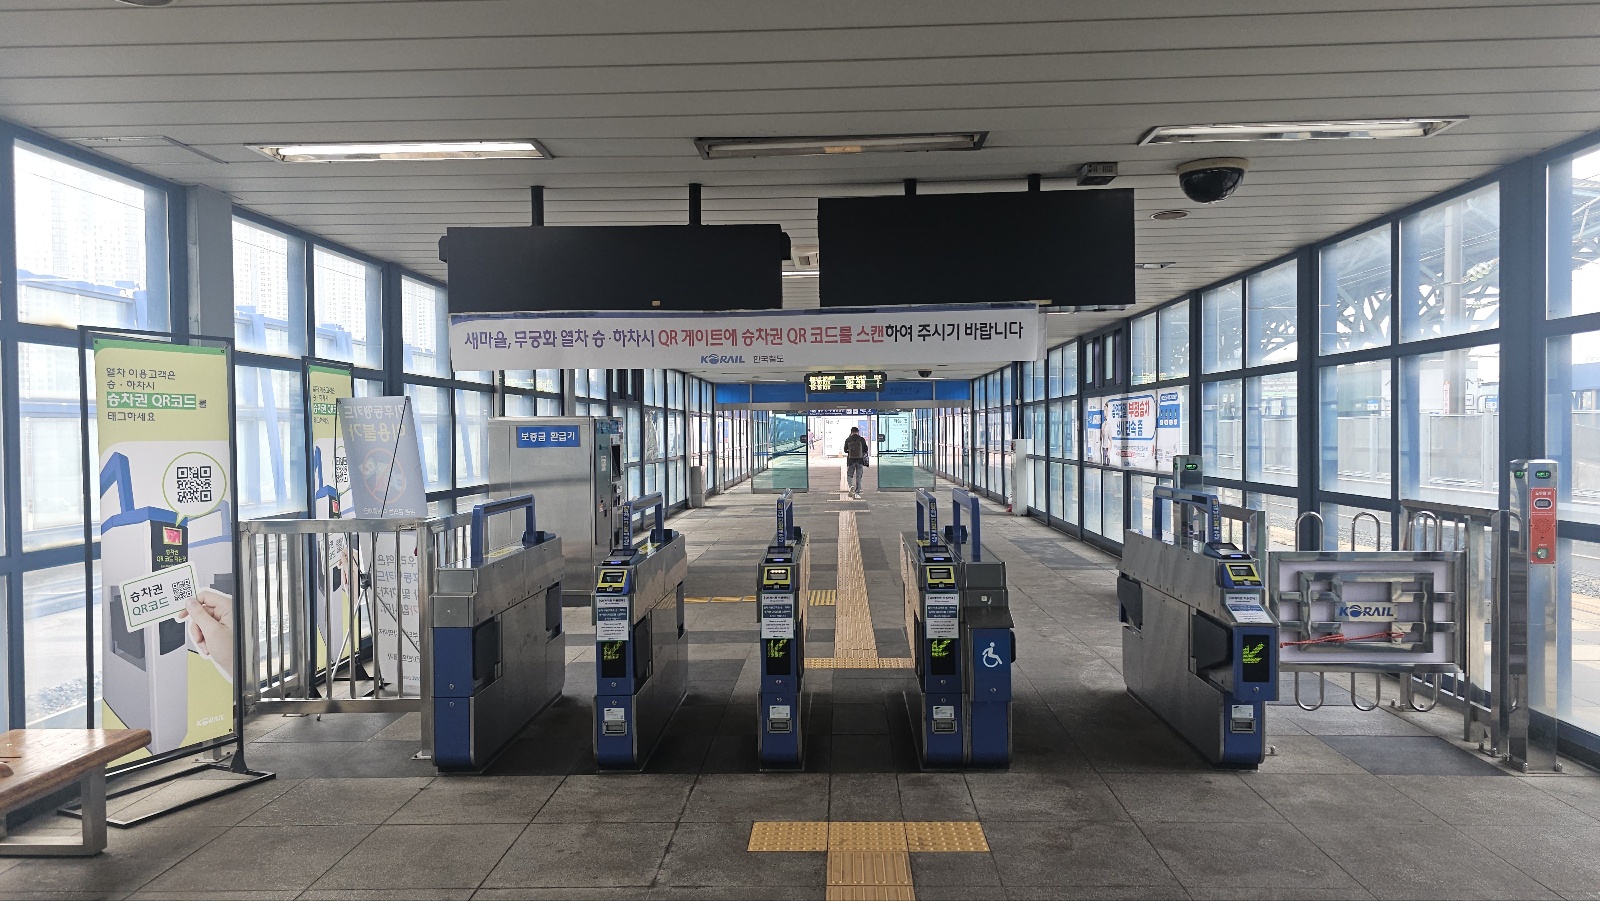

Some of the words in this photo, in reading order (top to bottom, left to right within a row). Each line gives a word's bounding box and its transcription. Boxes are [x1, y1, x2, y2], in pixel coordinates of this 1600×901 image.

[464, 331, 511, 350] 새마을,
[514, 329, 557, 349] 무궁화
[560, 329, 588, 348] 열차
[658, 329, 678, 348] QR
[681, 328, 737, 348] 게이트에
[741, 327, 783, 346] 승차권
[787, 327, 807, 345] QR
[810, 325, 852, 345] 코드를
[856, 323, 913, 344] 스캔하여
[917, 322, 960, 342] 주시기
[964, 321, 1023, 341] 바랍니다
[700, 353, 745, 365] KORAIL
[753, 355, 784, 364] 한국철도
[106, 367, 125, 378] 열차
[128, 368, 176, 380] 이용고객은
[107, 393, 148, 407] 승차권
[152, 394, 196, 408] QR코드
[107, 411, 155, 422] 태그하세요
[521, 432, 546, 442] 보증금
[550, 431, 575, 442] 환급기
[129, 583, 163, 603] 승차권
[132, 596, 170, 616] QR코드
[1338, 604, 1394, 618] KORAIL
[196, 714, 226, 727] KORAIL
